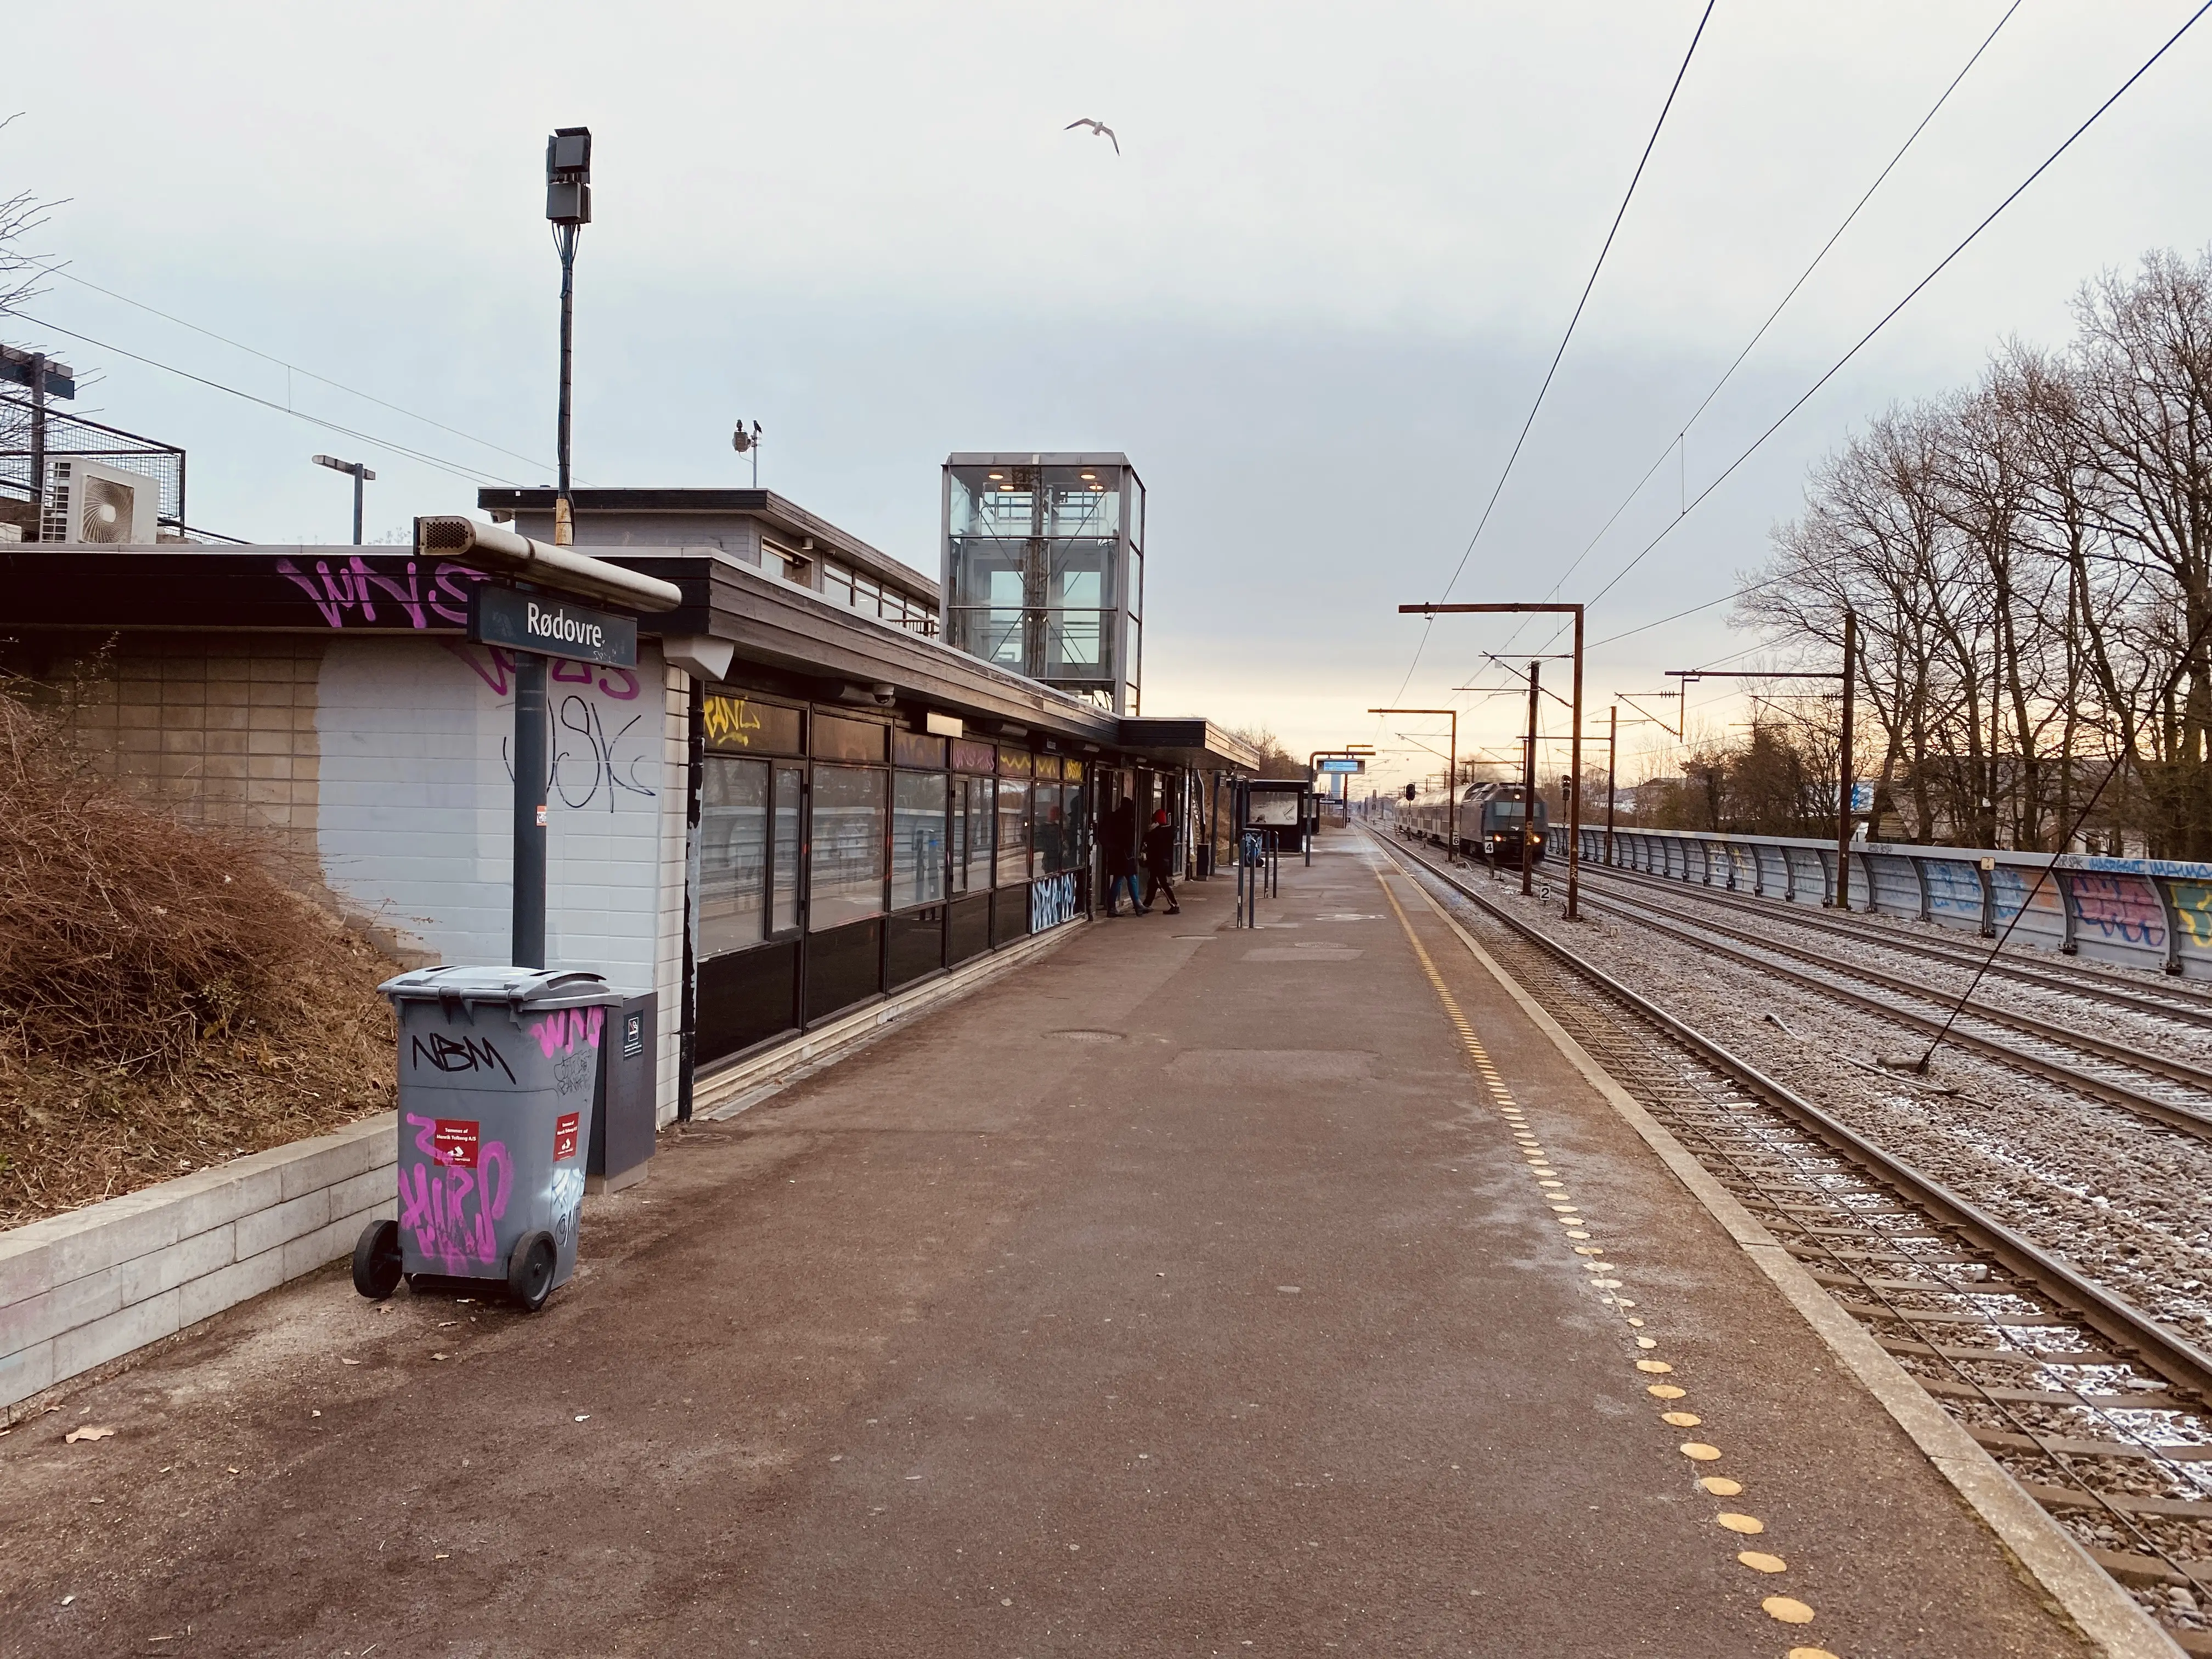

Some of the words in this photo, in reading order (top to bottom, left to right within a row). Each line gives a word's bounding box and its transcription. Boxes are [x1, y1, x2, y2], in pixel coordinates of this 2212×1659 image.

[527, 602, 602, 648] Rødovre
[1486, 843, 1493, 851] 4
[1541, 888, 1549, 899] 2
[411, 1031, 517, 1085] NBM
